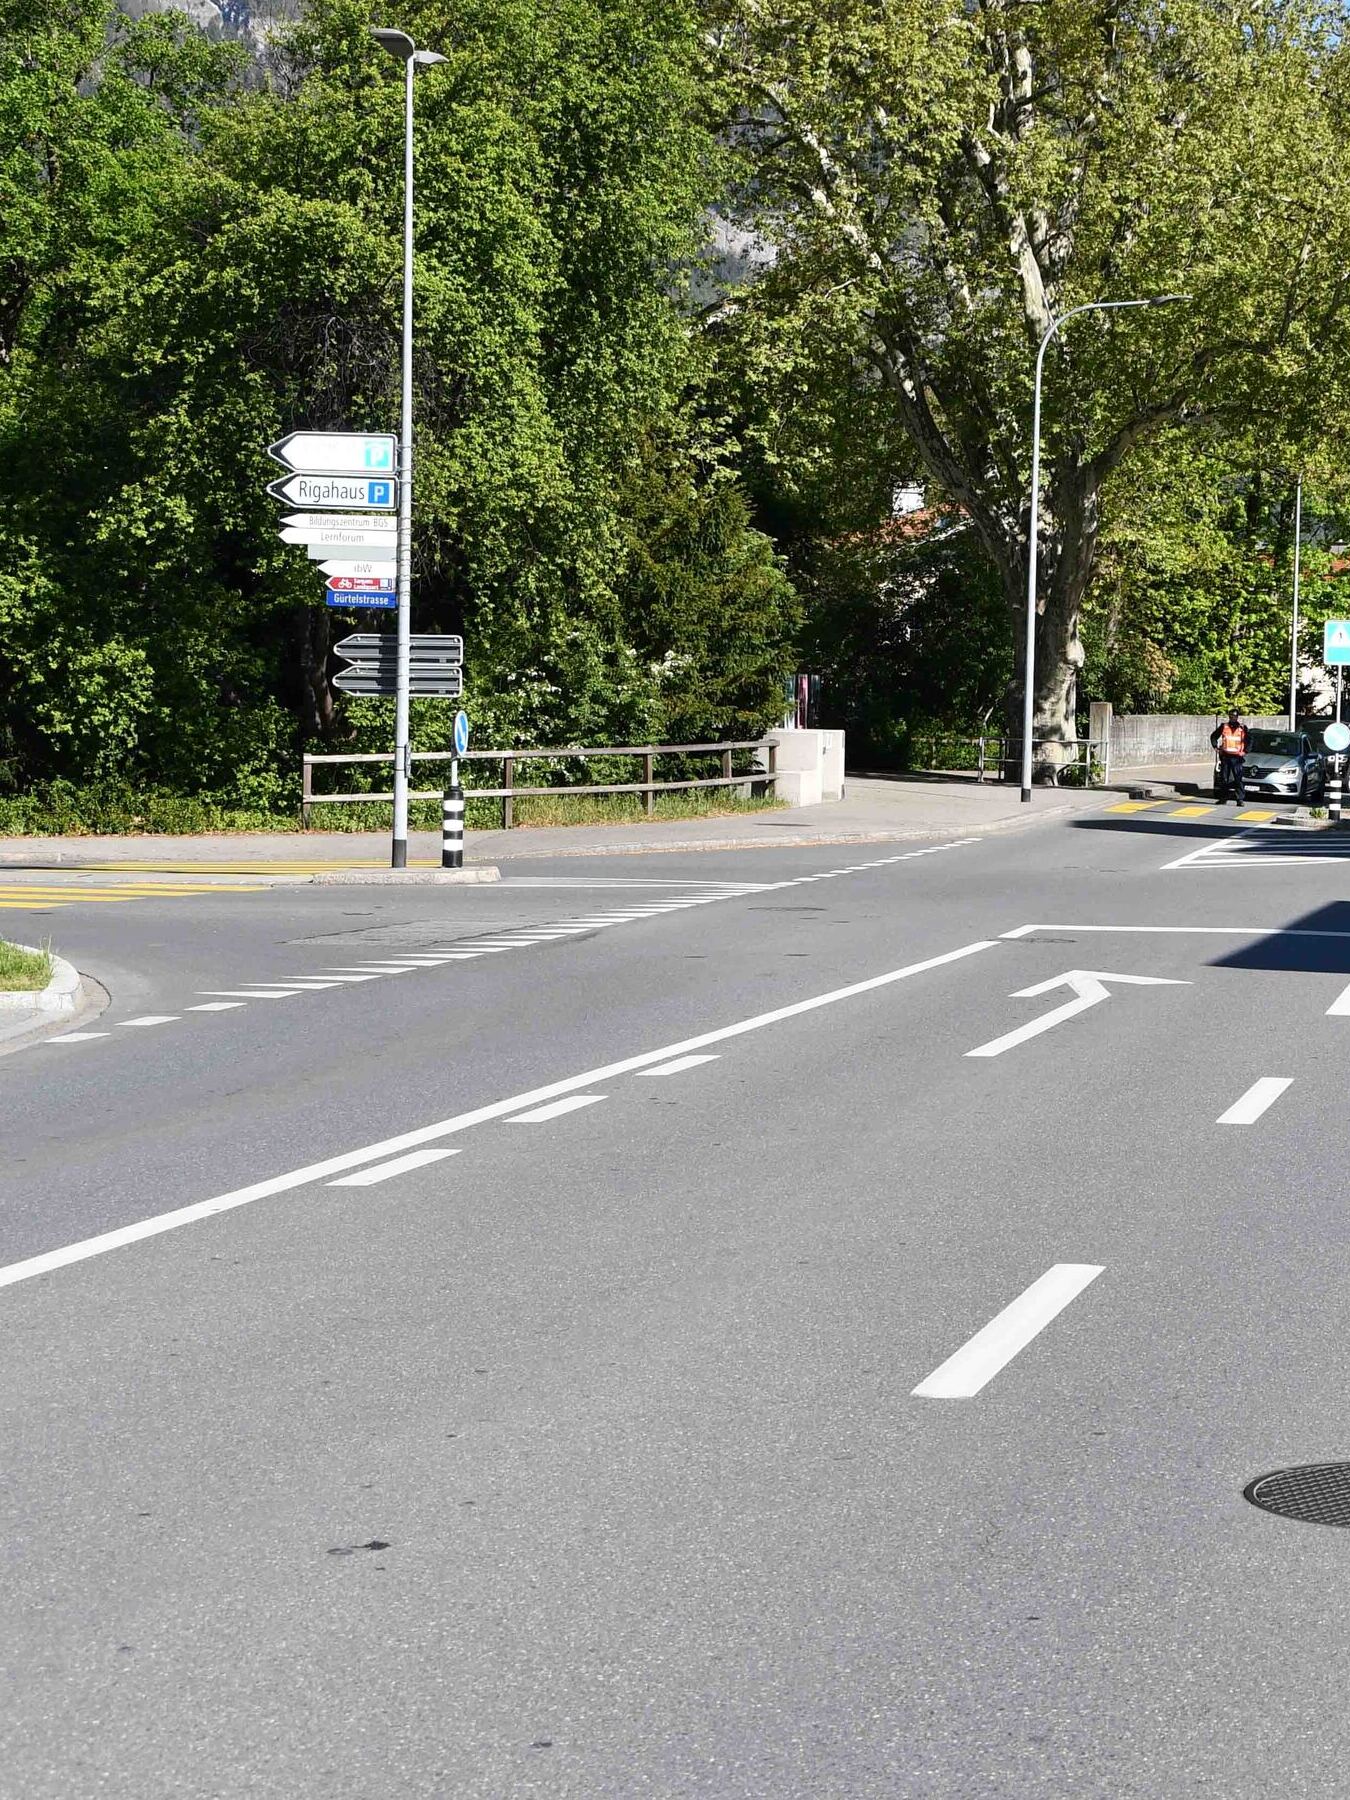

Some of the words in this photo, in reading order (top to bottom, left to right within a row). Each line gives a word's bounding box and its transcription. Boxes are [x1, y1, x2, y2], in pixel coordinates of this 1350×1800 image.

[299, 480, 365, 503] Rigahaus
[374, 486, 384, 502] P
[309, 516, 370, 528] Bildungszentrum
[320, 532, 364, 543] Lernforum
[334, 593, 389, 605] Gürtelstrasse
